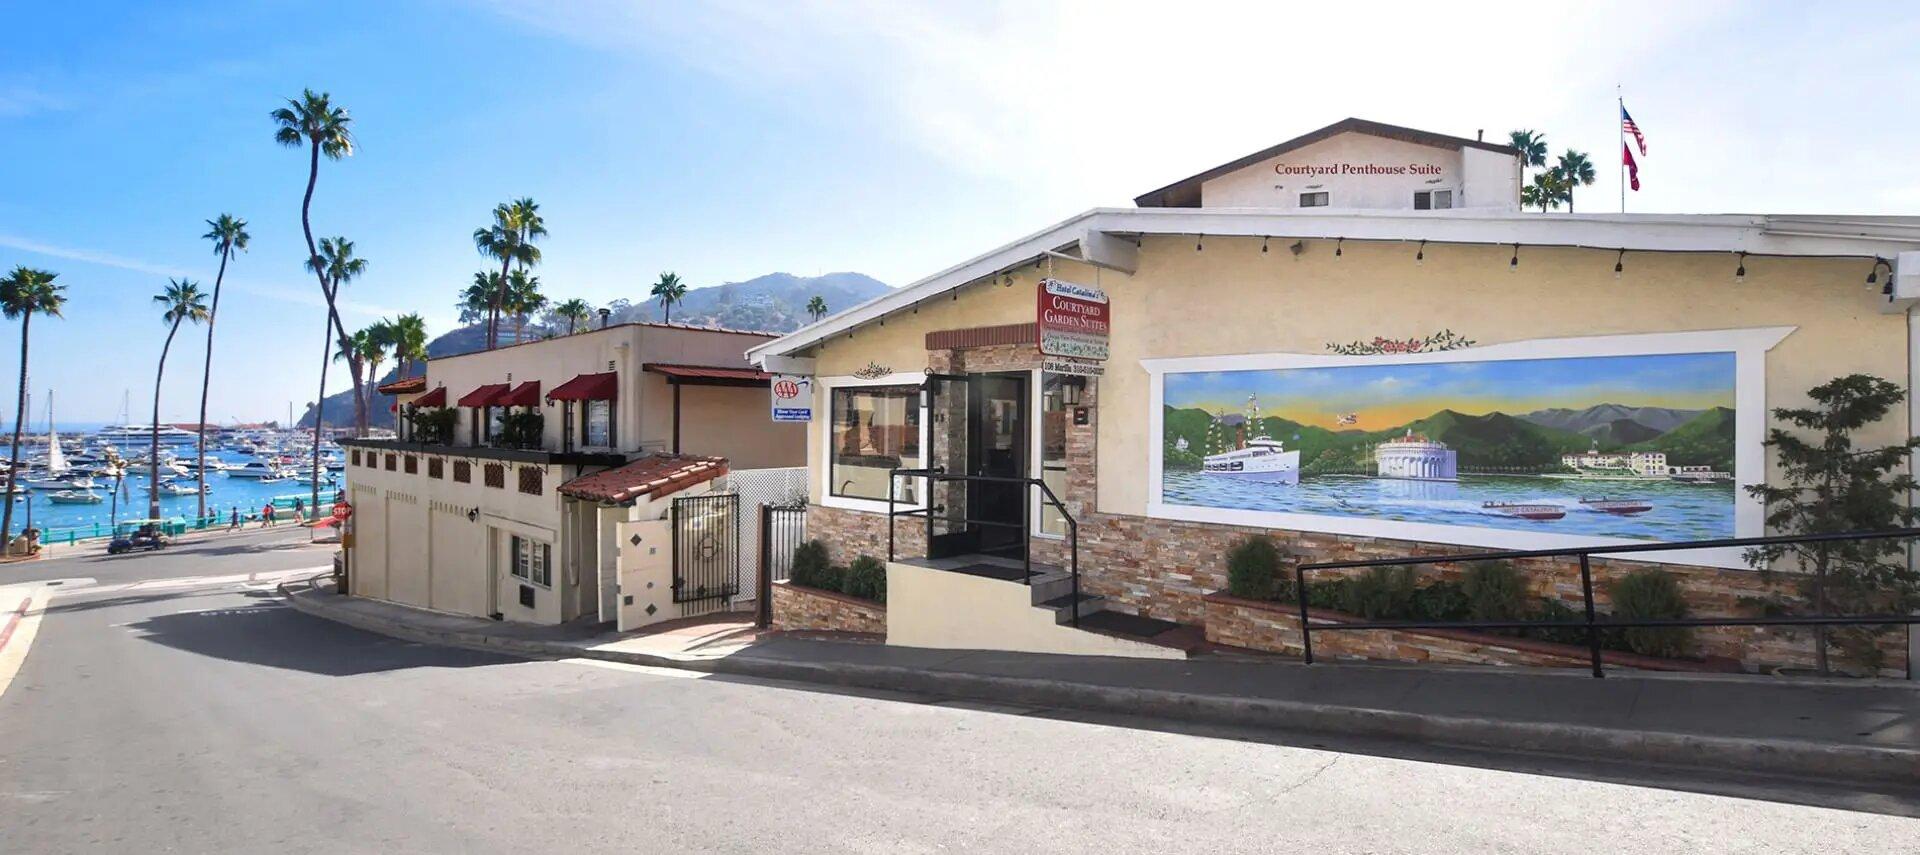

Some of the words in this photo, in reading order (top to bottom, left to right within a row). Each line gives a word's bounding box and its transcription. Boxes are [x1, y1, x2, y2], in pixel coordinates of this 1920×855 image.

[1275, 163, 1338, 178] Courtyard
[1342, 163, 1406, 175] Penthouse
[1409, 163, 1442, 175] Suite
[1056, 283, 1072, 294] Hotel
[1053, 295, 1101, 316] COURTYARD
[1044, 309, 1079, 327] GARDEN
[1080, 315, 1108, 330] SUITES
[775, 381, 797, 398] AAA
[333, 507, 351, 516] STOP
